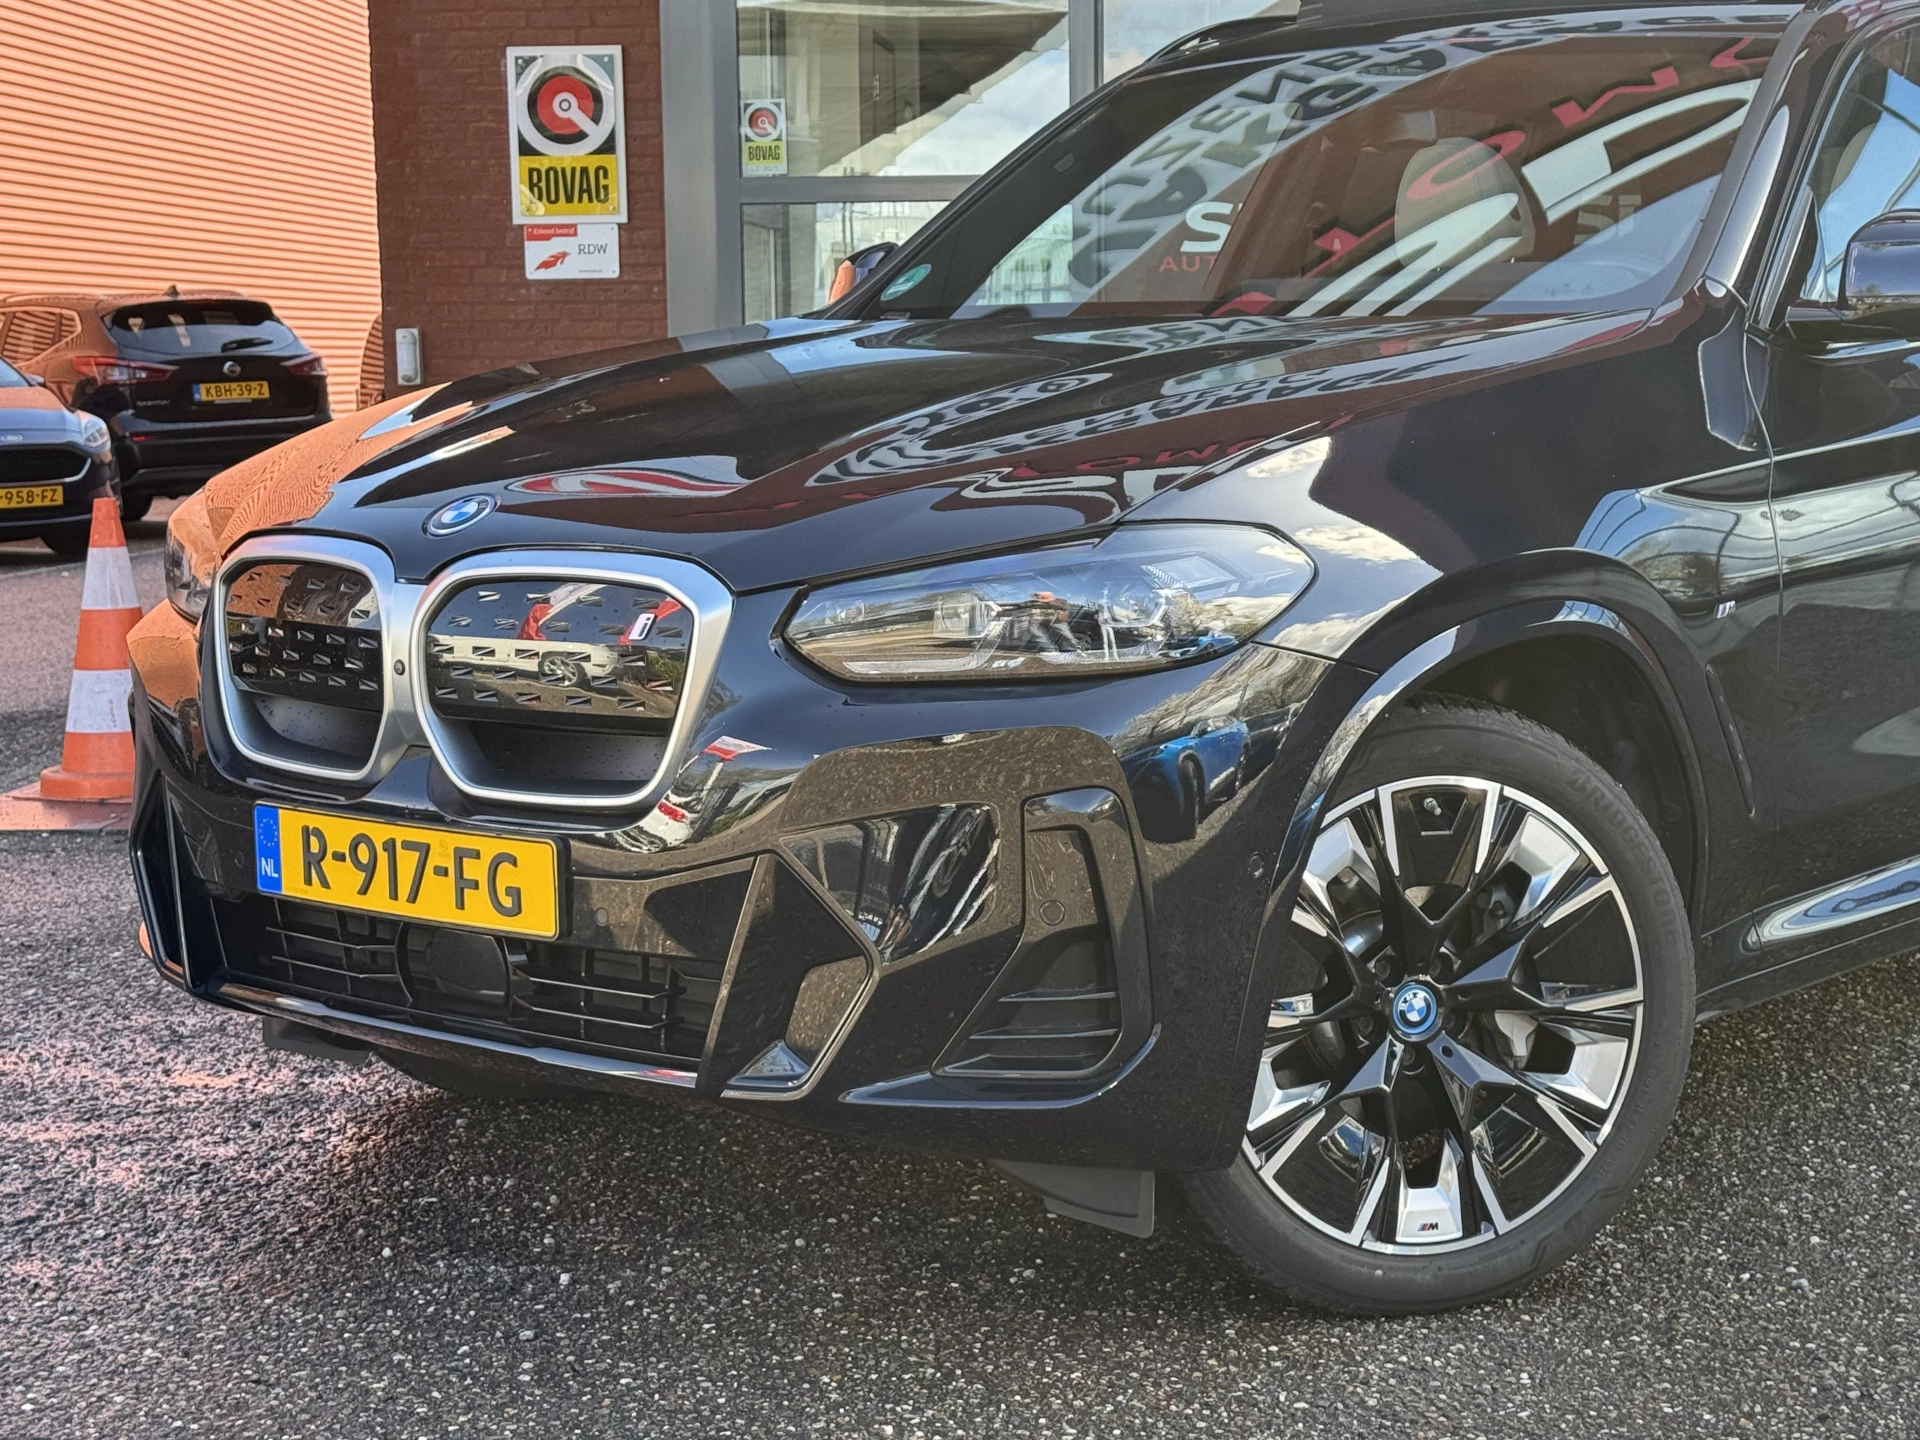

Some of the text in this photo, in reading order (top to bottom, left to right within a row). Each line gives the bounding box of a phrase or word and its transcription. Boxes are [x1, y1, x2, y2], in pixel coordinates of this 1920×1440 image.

[748, 144, 781, 162] BOVAG
[527, 164, 610, 205] BOVAG
[577, 243, 609, 256] RDW
[205, 383, 265, 398] KBH-39-Z
[261, 856, 279, 878] NL
[301, 824, 523, 918] R-917-FG
